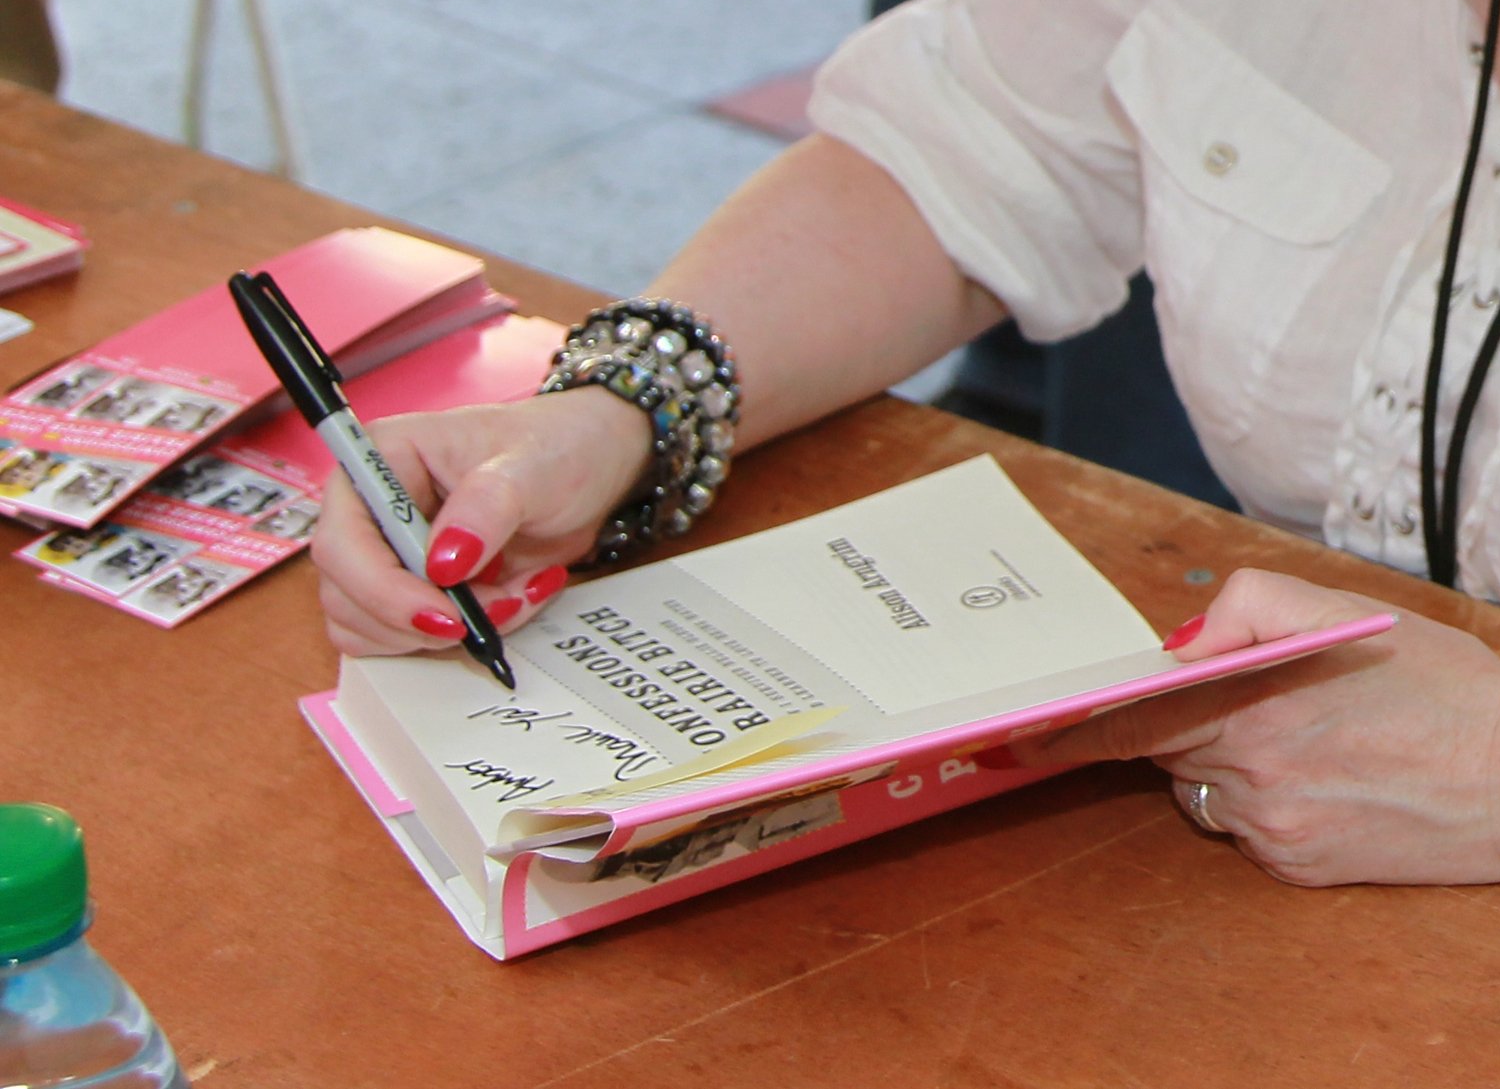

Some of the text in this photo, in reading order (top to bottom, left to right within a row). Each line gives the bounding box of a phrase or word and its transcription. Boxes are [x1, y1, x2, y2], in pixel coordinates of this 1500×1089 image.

[826, 537, 931, 630] Alison Arngrim
[554, 634, 727, 754] ONFESSIONS
[577, 606, 771, 732] RAIRIE BITCH
